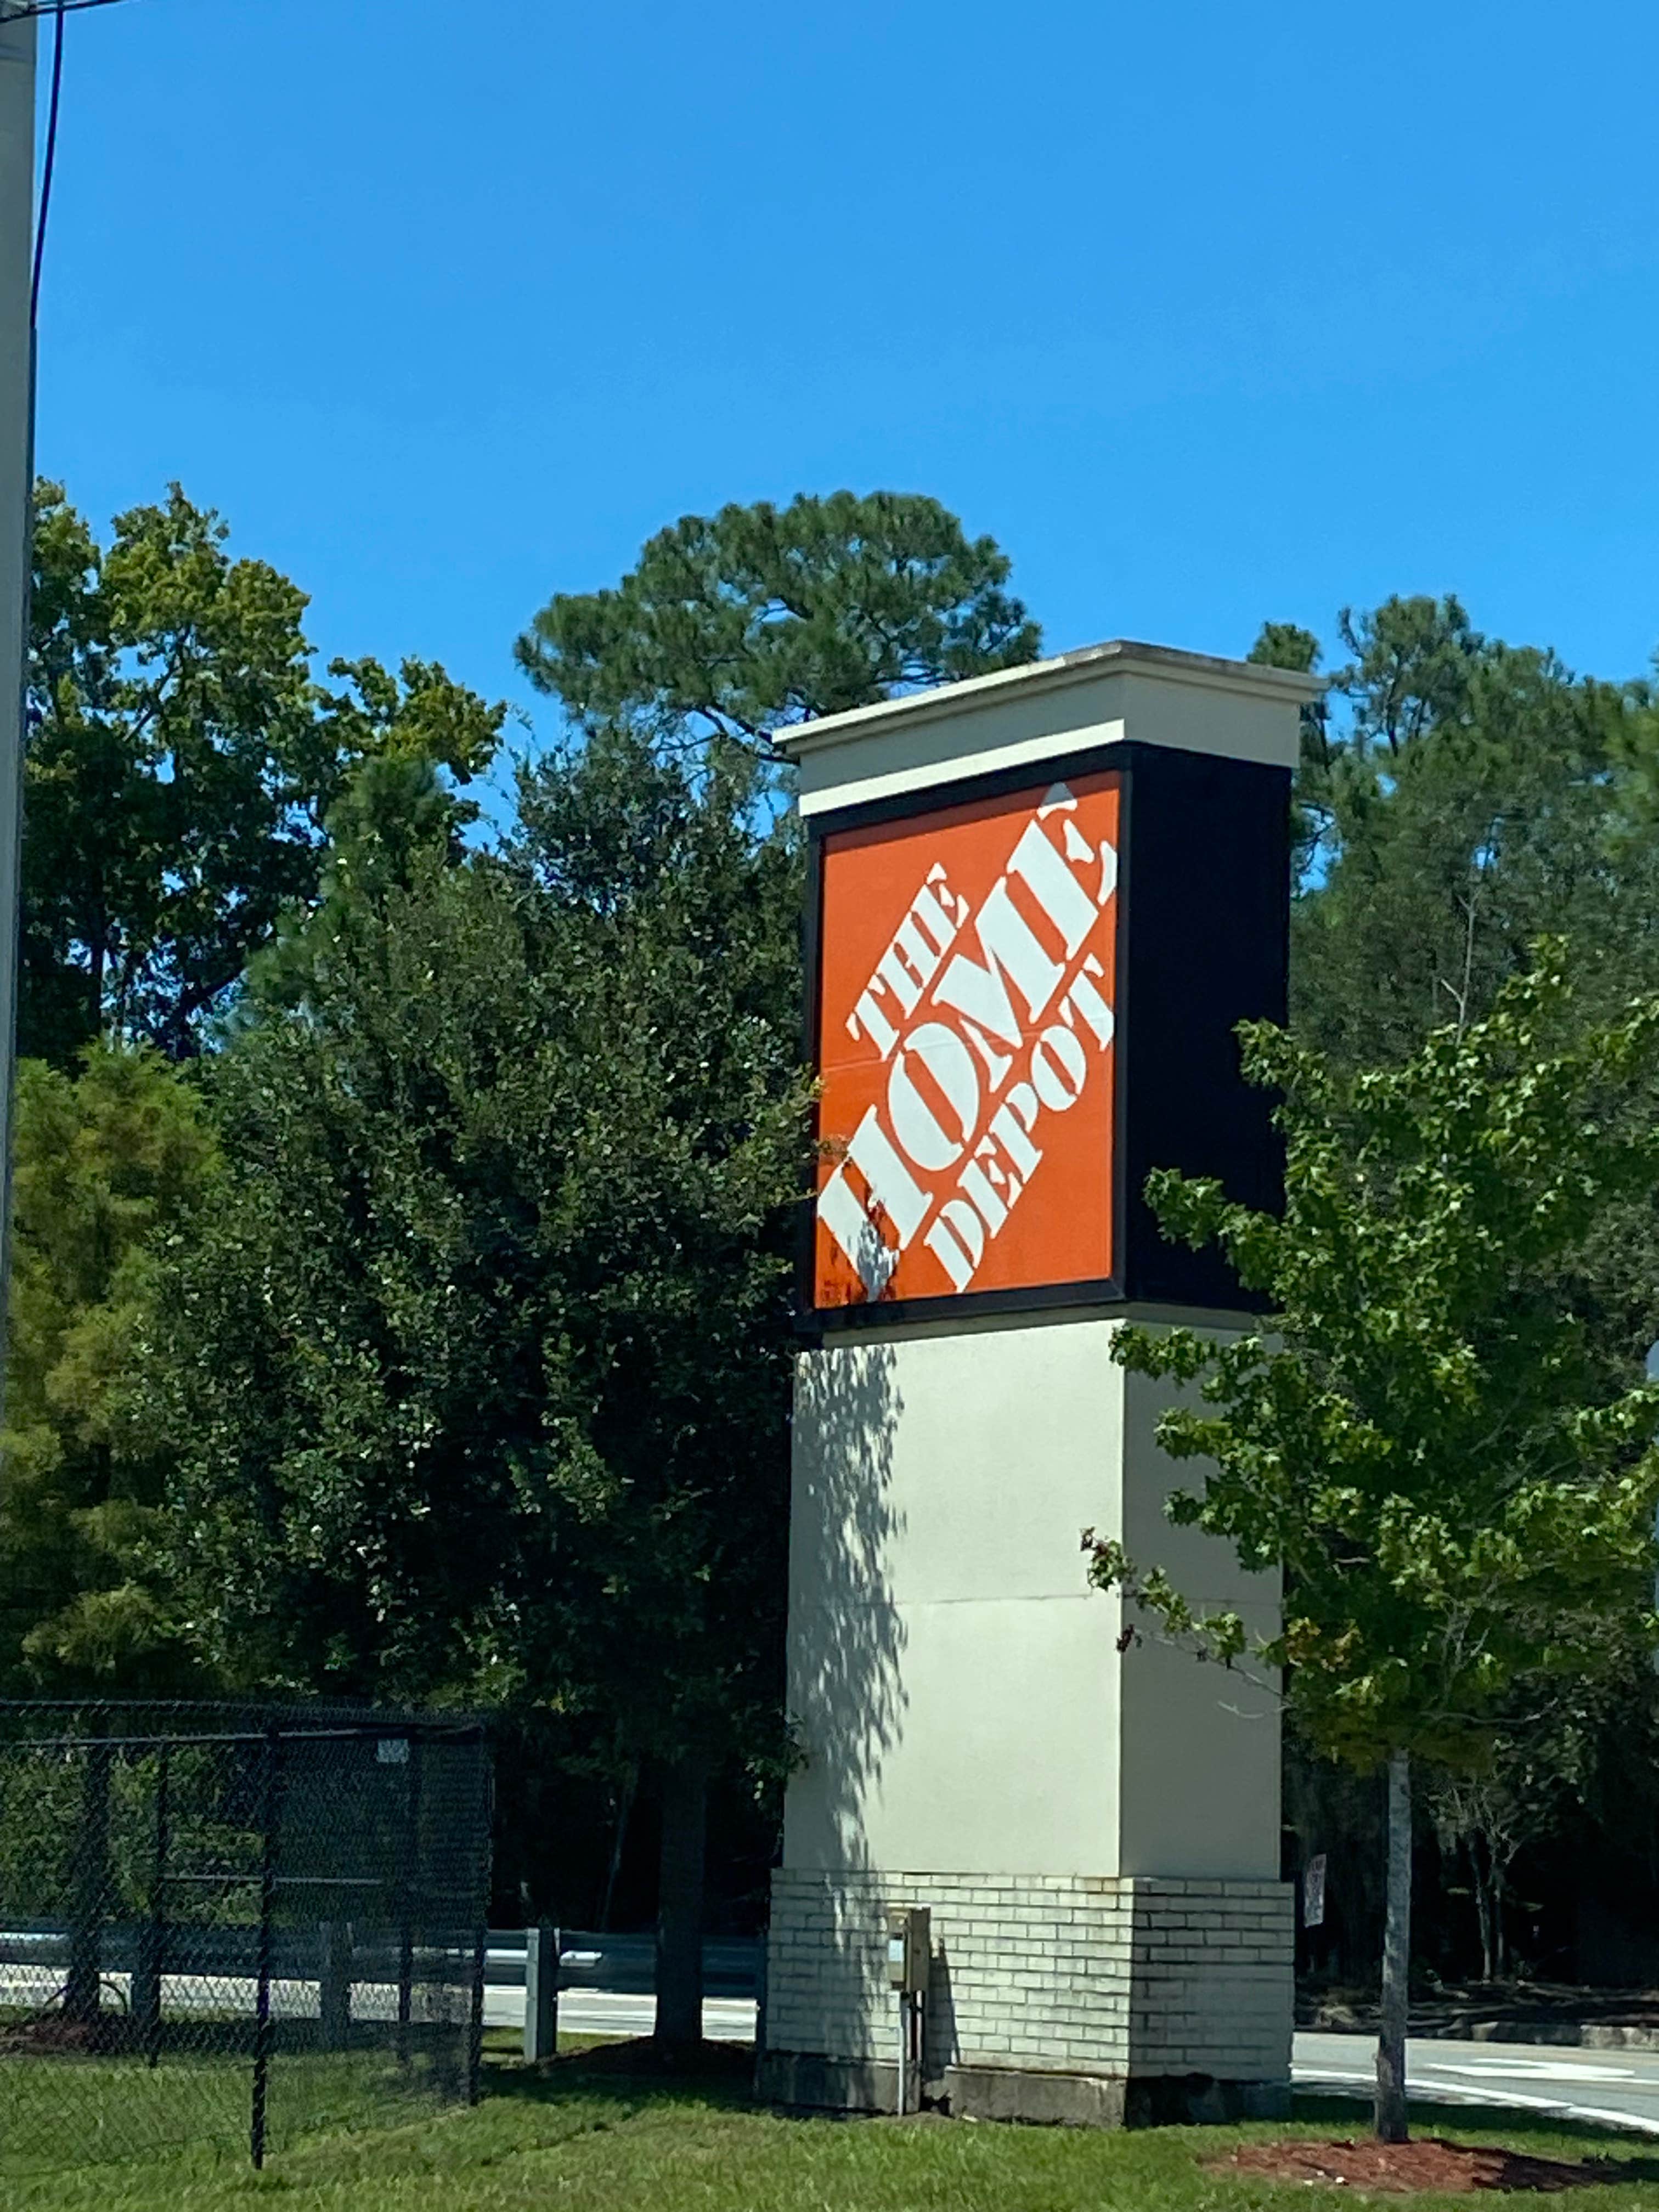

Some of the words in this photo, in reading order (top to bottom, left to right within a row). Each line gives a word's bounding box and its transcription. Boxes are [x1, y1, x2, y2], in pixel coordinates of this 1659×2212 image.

[817, 781, 1118, 1302] HOME
[845, 862, 969, 1061] THE
[923, 952, 1114, 1294] DEPOT
